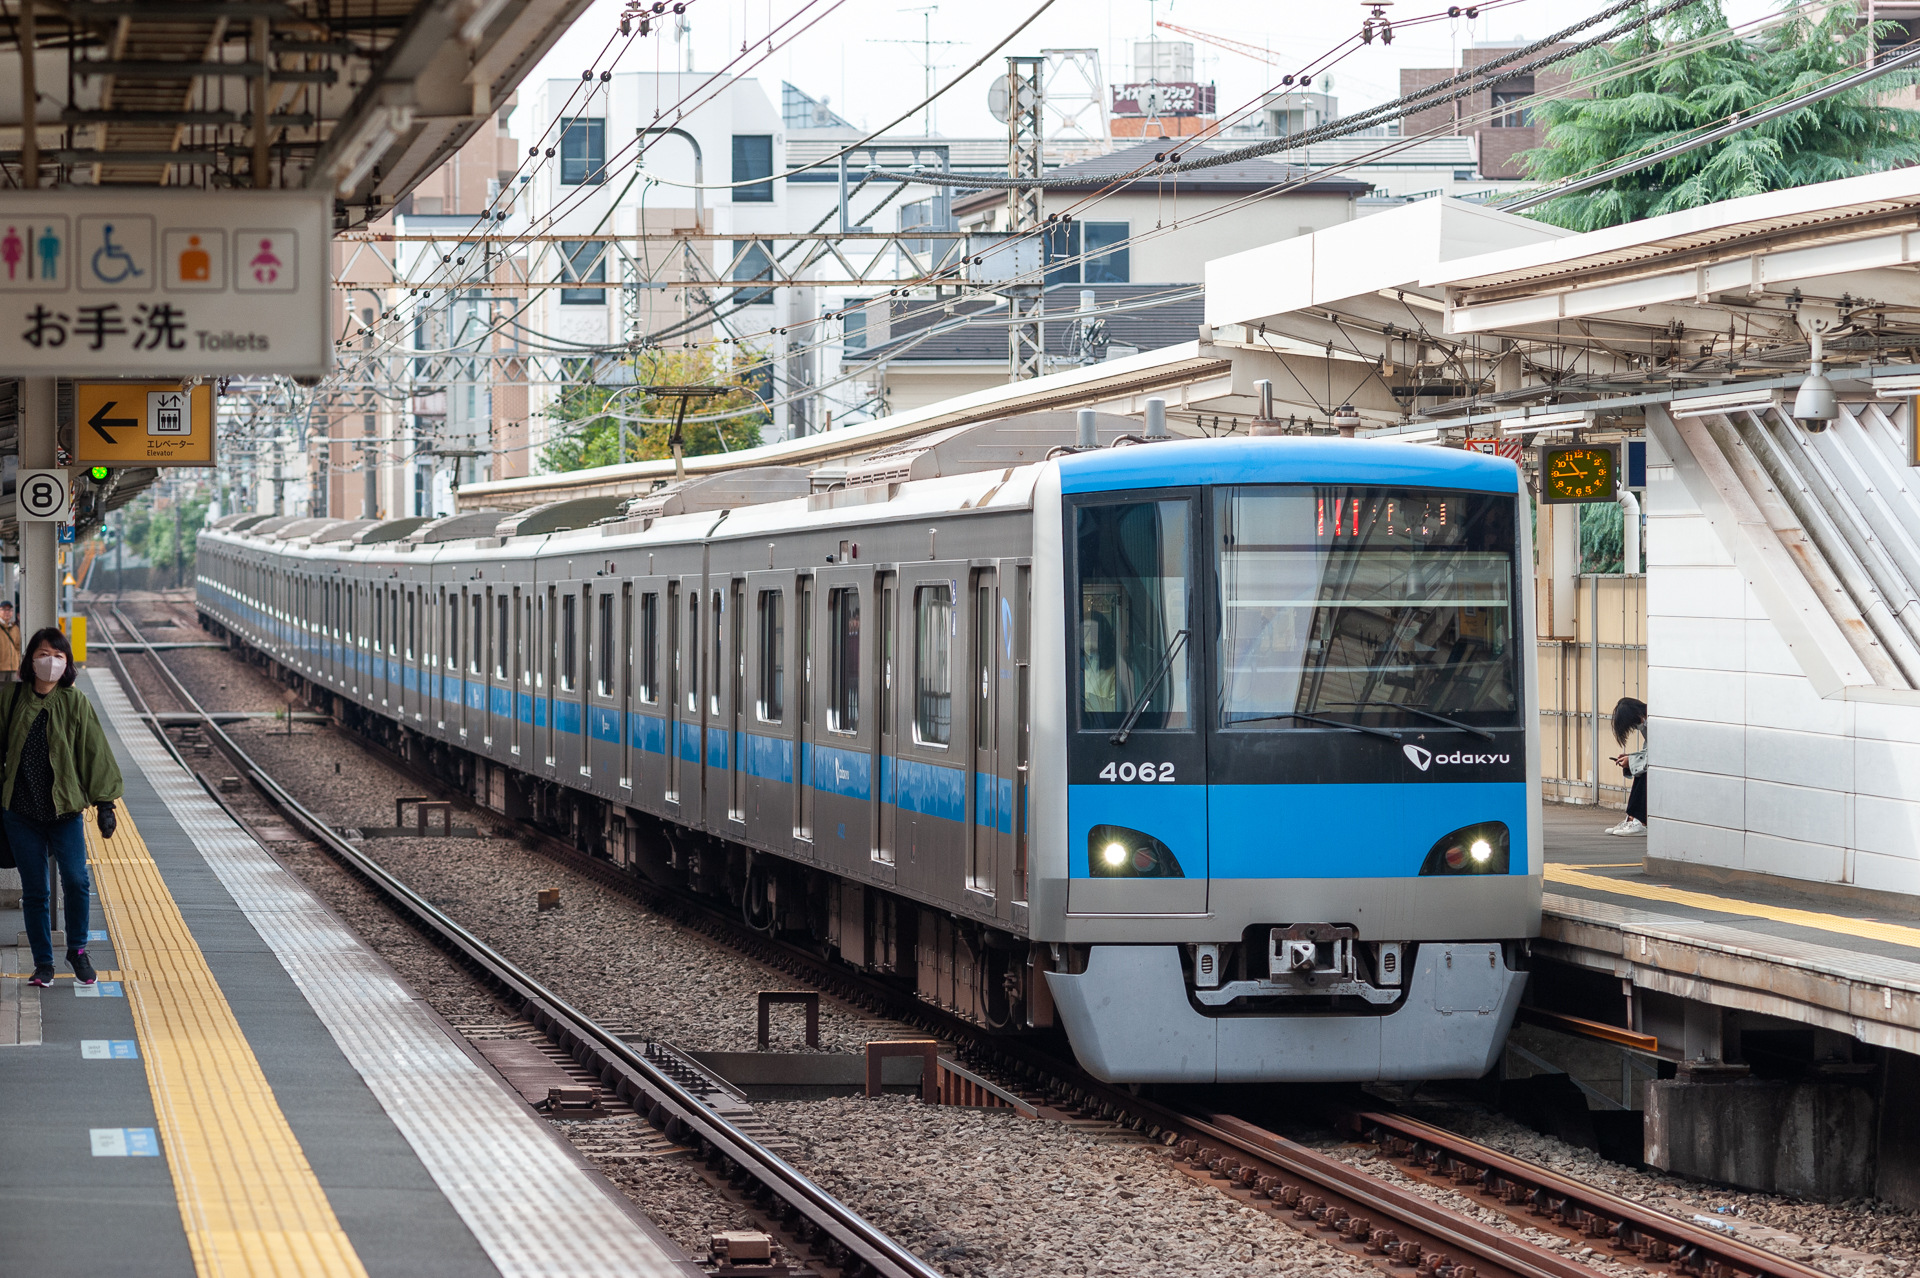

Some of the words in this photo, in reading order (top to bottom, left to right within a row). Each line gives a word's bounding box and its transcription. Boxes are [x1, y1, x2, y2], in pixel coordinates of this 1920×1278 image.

[21, 302, 187, 351] お手洗
[195, 329, 270, 352] Toilets
[147, 439, 195, 449] エレベーター
[147, 449, 174, 458] Elevator
[31, 482, 53, 508] 8
[1435, 751, 1510, 764] odakyu
[1099, 762, 1176, 782] 4062
